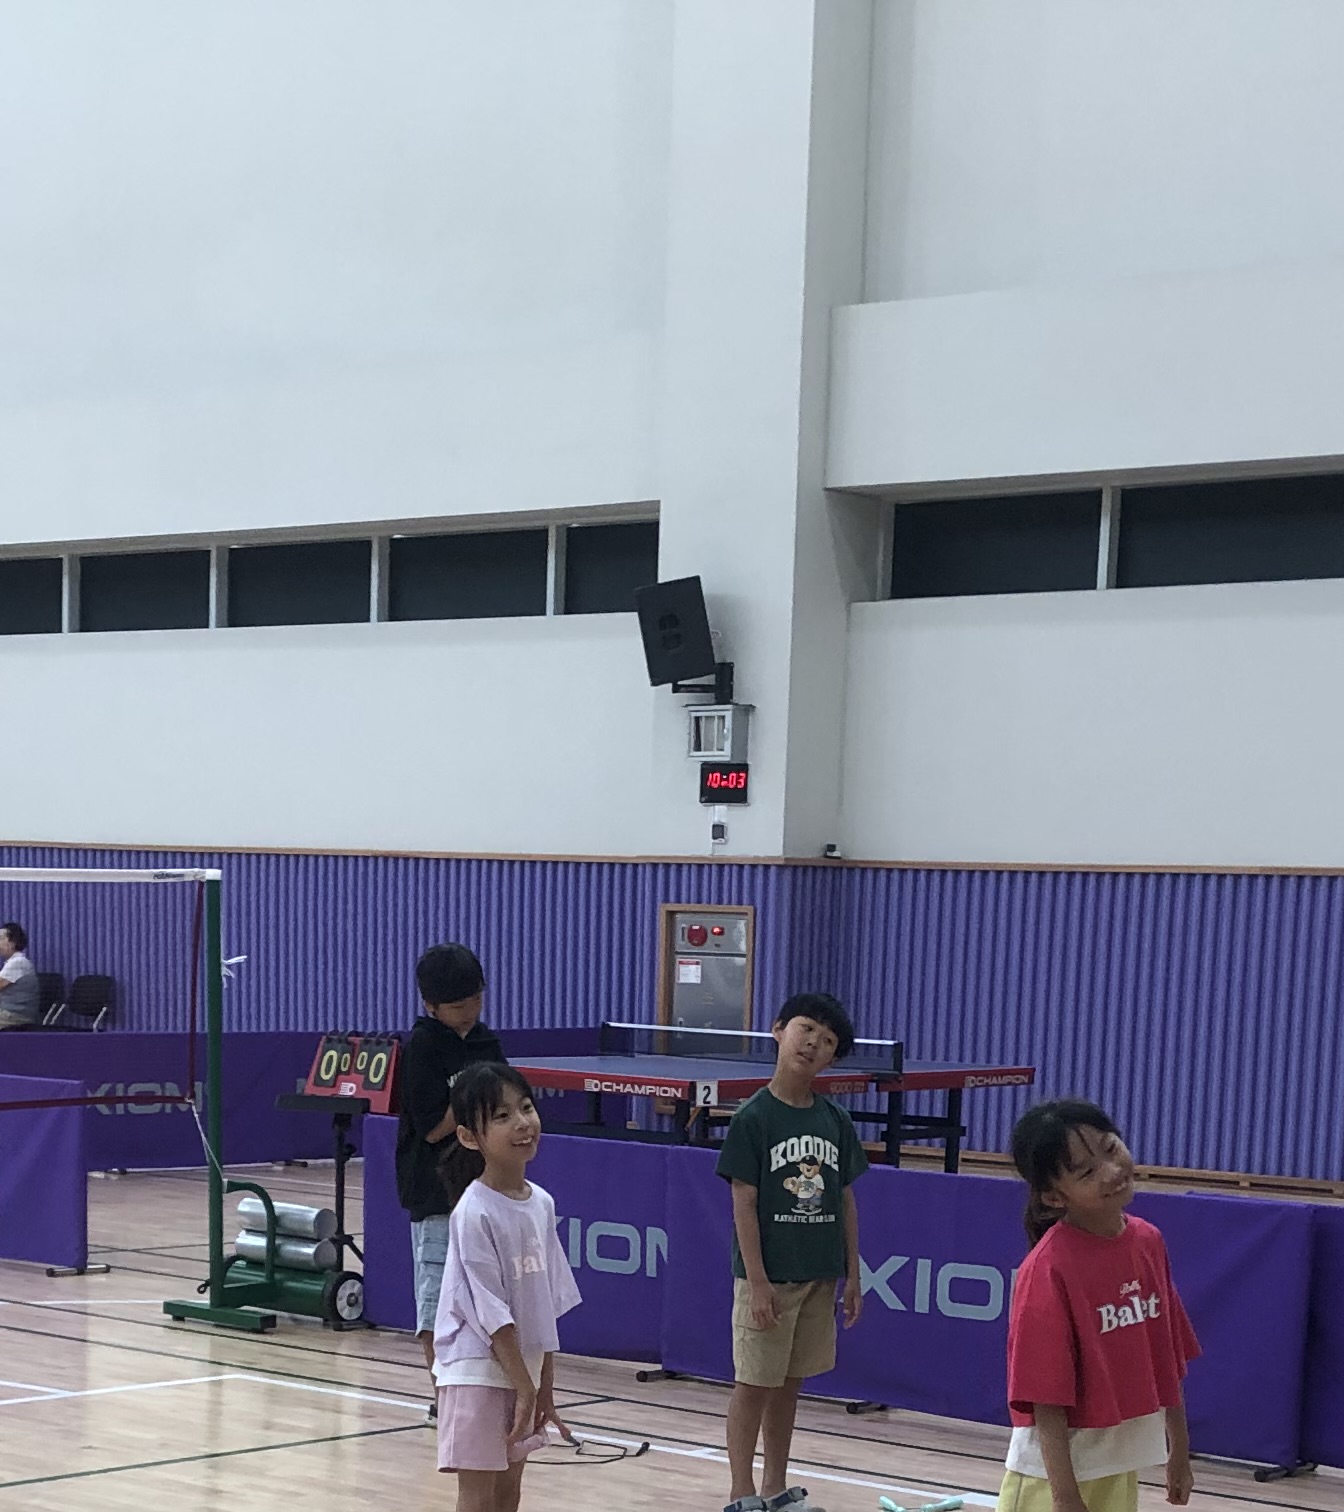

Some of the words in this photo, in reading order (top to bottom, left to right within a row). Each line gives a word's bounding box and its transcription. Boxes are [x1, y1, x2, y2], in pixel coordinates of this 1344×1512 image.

[707, 772, 746, 788] 10:03
[320, 1050, 338, 1080] 0
[340, 1053, 351, 1072] 0
[357, 1051, 368, 1071] 0
[369, 1052, 387, 1084] 0
[601, 1082, 682, 1098] CHAMPION
[702, 1085, 712, 1105] 2
[556, 1215, 668, 1278] IO
[840, 1254, 1018, 1322] XIO
